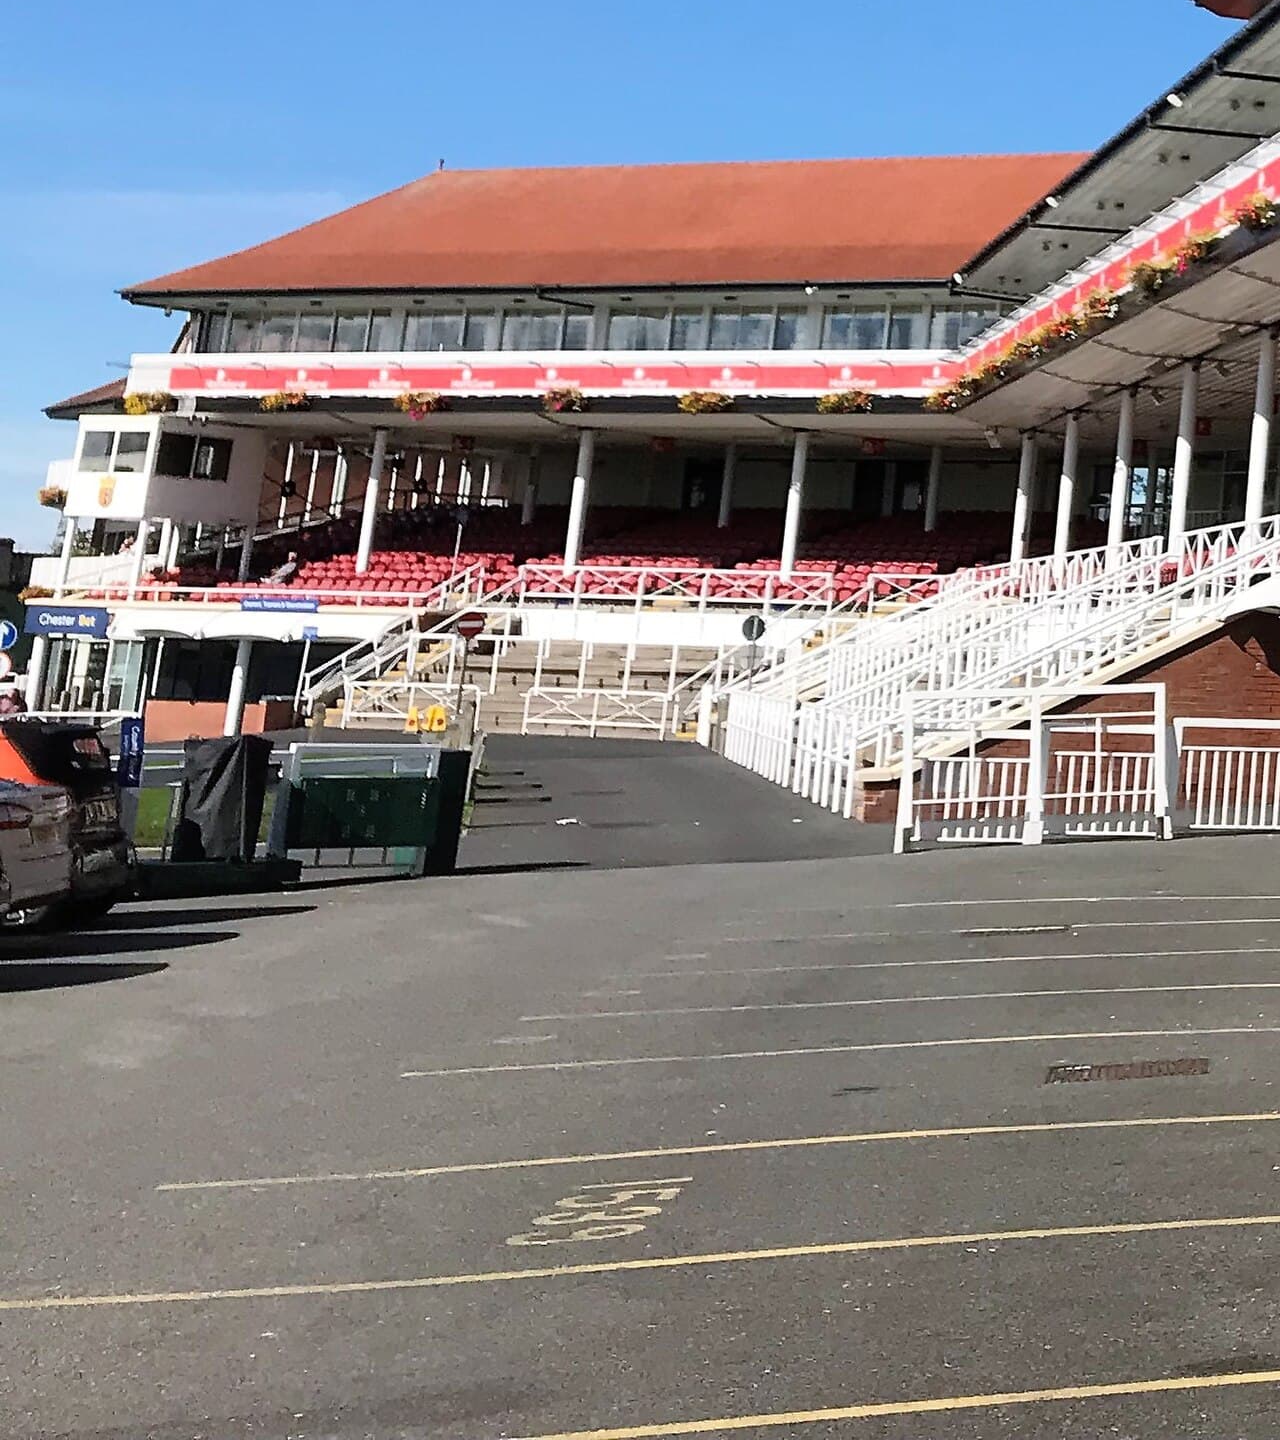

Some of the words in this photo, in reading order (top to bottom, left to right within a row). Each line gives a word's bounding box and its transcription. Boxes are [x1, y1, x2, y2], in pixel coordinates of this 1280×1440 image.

[38, 612, 76, 627] Chester
[78, 614, 97, 628] Bet
[504, 1176, 694, 1247] 1539
